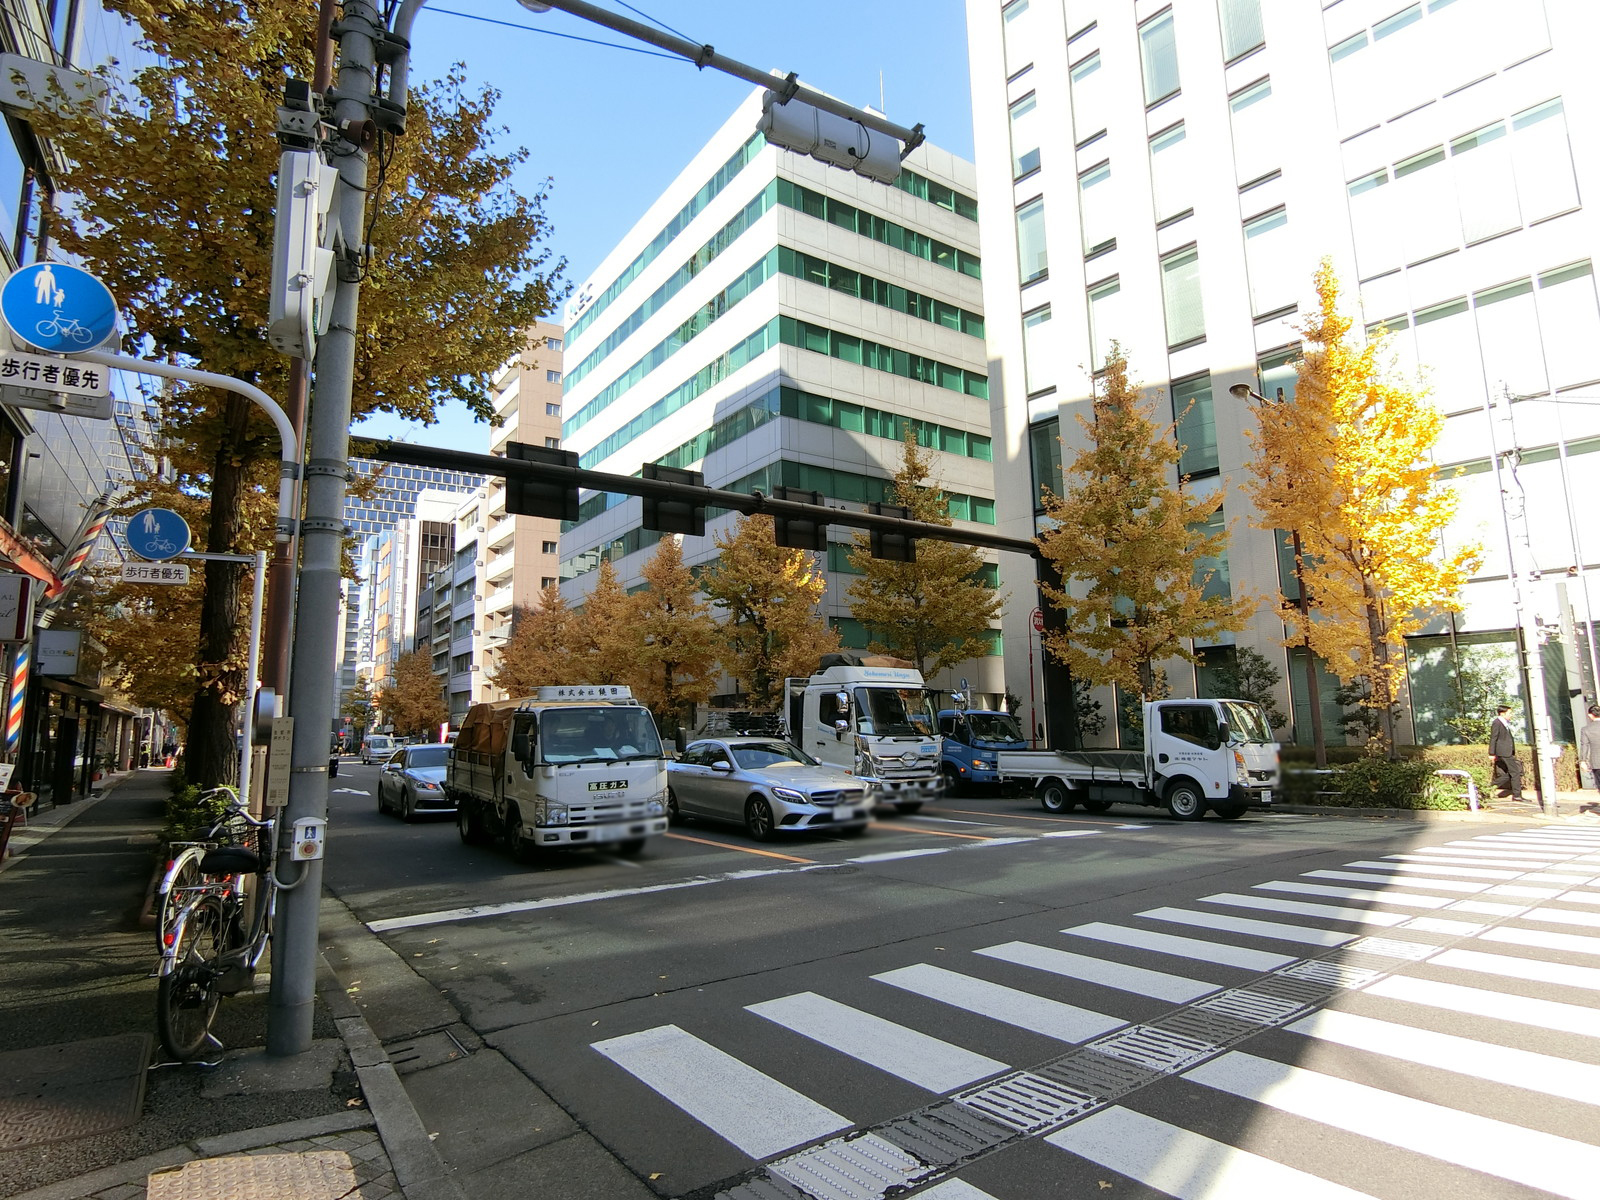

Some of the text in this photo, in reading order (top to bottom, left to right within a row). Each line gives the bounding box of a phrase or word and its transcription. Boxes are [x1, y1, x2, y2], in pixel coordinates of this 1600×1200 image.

[1, 358, 100, 390] 歩行者優先
[126, 566, 184, 579] 歩行者優先
[589, 780, 628, 791] 高圧ガス
[593, 791, 625, 800] ISUZU
